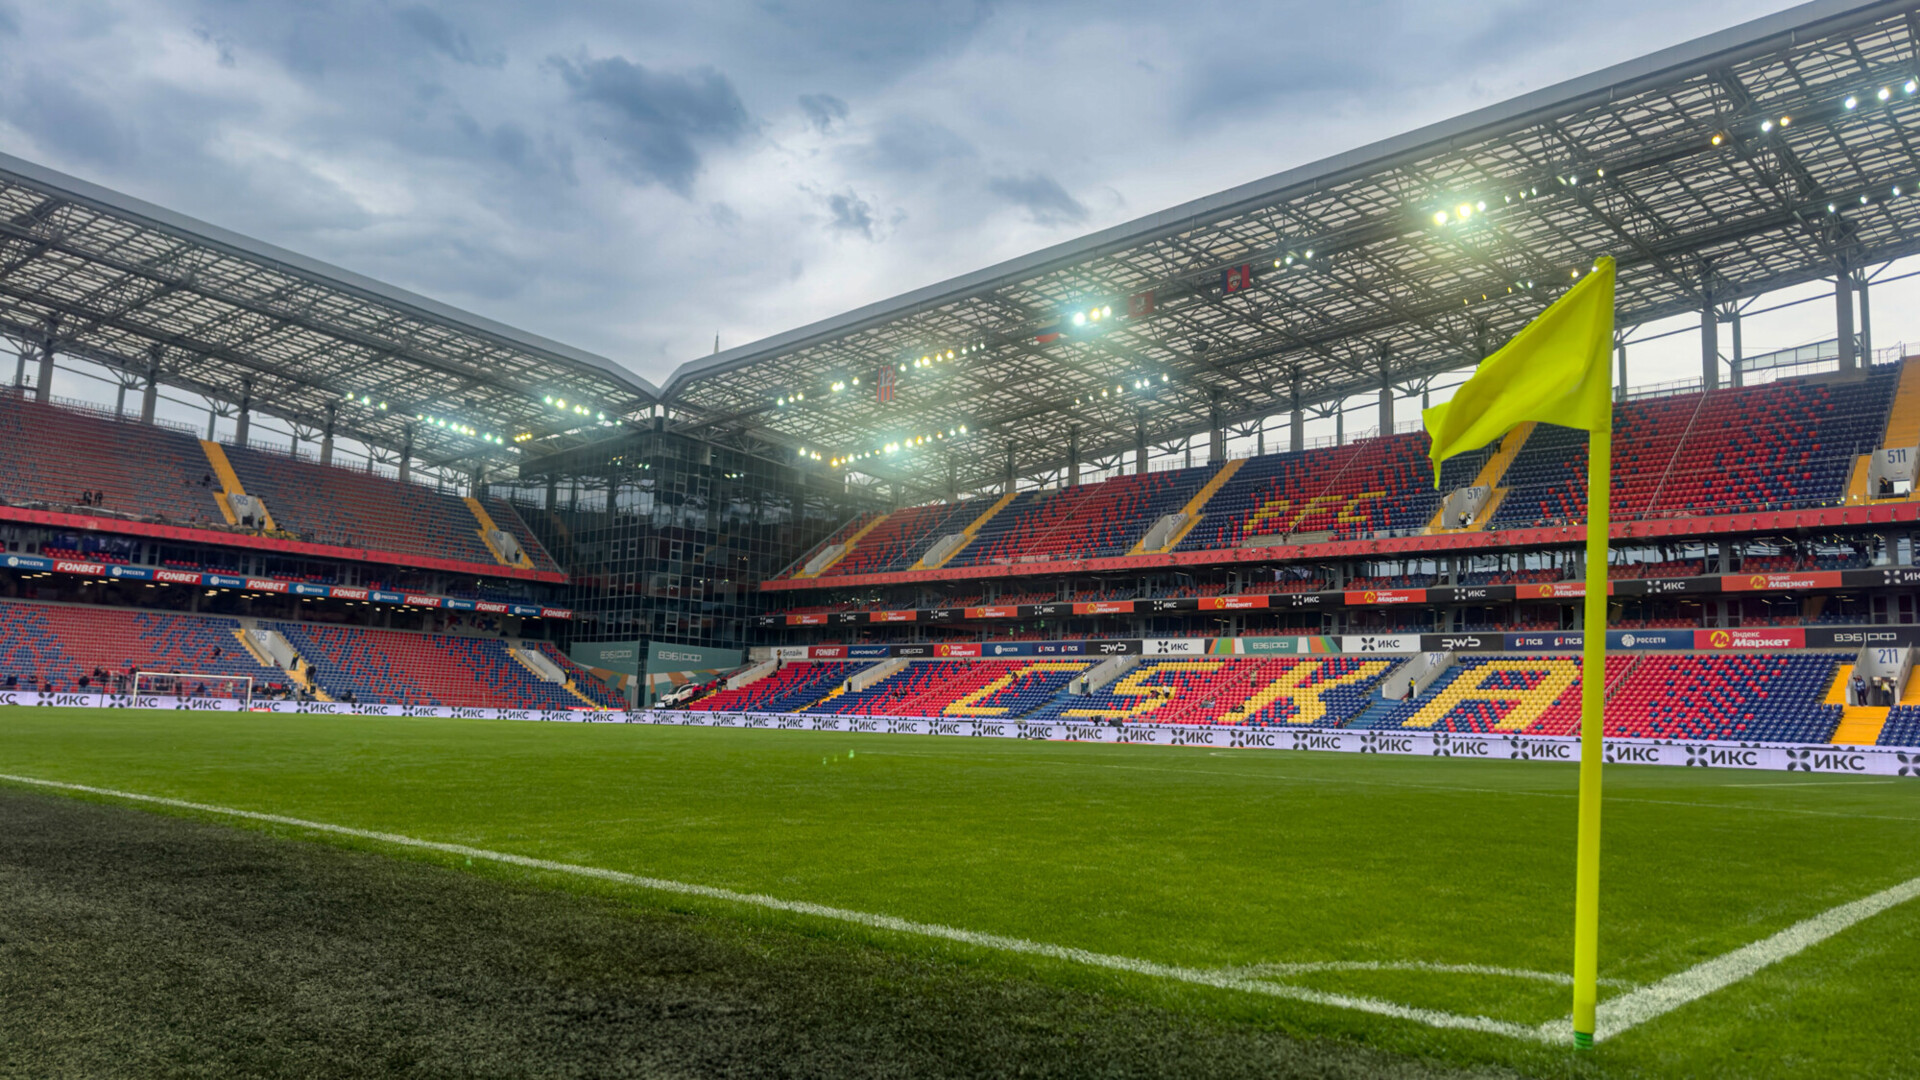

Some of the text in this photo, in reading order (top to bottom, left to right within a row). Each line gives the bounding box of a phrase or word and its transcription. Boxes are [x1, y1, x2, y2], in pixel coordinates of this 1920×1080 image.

[1887, 448, 1906, 464] 511
[1467, 486, 1481, 500] 510
[57, 561, 104, 574] FONBET
[157, 571, 199, 583] FONBET
[1904, 572, 1920, 581] ИК
[248, 580, 286, 591] FONBET
[1663, 582, 1685, 590] ИКС
[1768, 580, 1815, 588] Маркет
[332, 588, 367, 599] FONBET
[1376, 595, 1408, 603] Маркет
[1467, 589, 1486, 598] ИКС
[407, 595, 439, 606] FONBET
[1163, 601, 1177, 609] ИКС
[1303, 596, 1319, 604] ИКС
[477, 603, 506, 613] FONBET
[543, 609, 571, 618] FONBET
[1170, 643, 1188, 651] ИКС
[1378, 639, 1400, 648] ИКС
[1526, 637, 1582, 646] ПСБ ПСБ
[1732, 638, 1791, 648] Маркет
[815, 648, 840, 656] FONBET
[1878, 648, 1898, 664] 211
[942, 659, 1581, 729] CSKA
[55, 695, 90, 706] ИКС
[126, 696, 157, 708] ИКС
[192, 698, 222, 710] ИКС
[310, 702, 336, 713] ИКС
[364, 704, 388, 715] ИКС
[415, 707, 438, 717] ИКС
[463, 708, 484, 718] ИКС
[508, 709, 530, 719] ИКС
[551, 711, 571, 721] ИКС
[593, 713, 614, 722] ИКС
[633, 714, 646, 723] ИКС
[661, 714, 674, 724] ИКС
[690, 715, 705, 724] ИКС
[721, 716, 736, 725] ИКС
[753, 717, 768, 727] ИКС
[786, 718, 803, 728] ИКС
[822, 719, 839, 729] ИКС
[859, 720, 877, 731] ИКС
[897, 722, 917, 732] ИКС
[940, 723, 959, 734] ИКС
[983, 725, 1004, 736] ИКС
[1029, 726, 1052, 737] ИКС
[1079, 728, 1102, 739] ИКС
[1130, 730, 1156, 741] ИКС
[1186, 731, 1213, 743] ИКС
[1245, 733, 1275, 746] ИКС
[1310, 736, 1341, 749] ИКС
[1379, 738, 1412, 752] ИКС
[1452, 741, 1488, 755] ИКС
[1531, 743, 1570, 758] ИКС
[1617, 746, 1659, 762] ИКС
[1711, 750, 1757, 765] ИКС
[1814, 754, 1865, 771] ИКС
